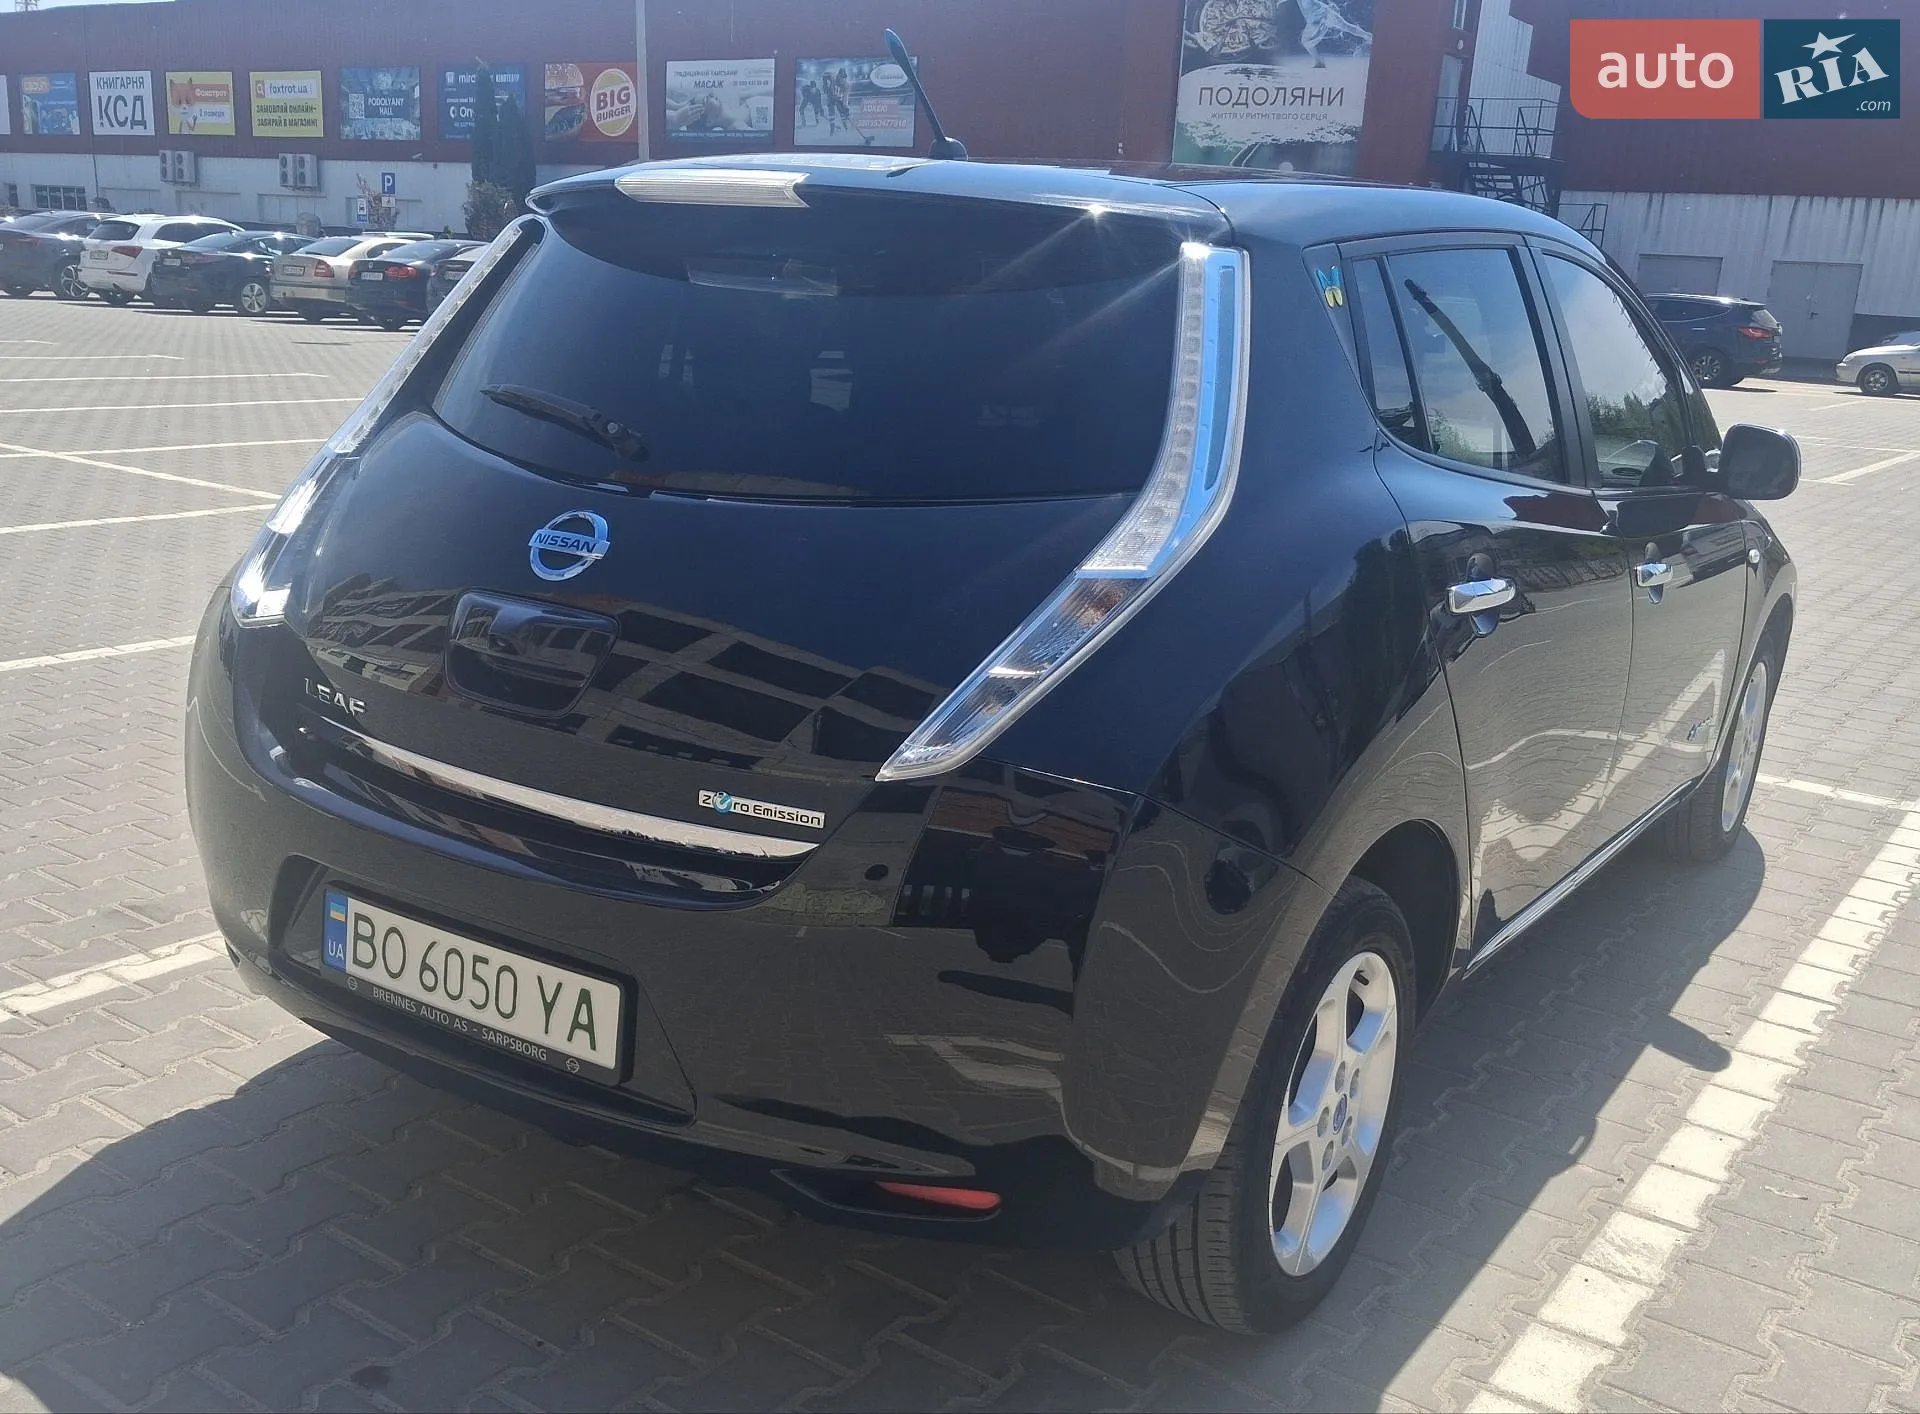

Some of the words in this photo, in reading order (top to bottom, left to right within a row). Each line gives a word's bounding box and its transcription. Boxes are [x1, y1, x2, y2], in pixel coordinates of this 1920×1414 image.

[96, 76, 145, 90] КНИГАРНЯ
[269, 84, 308, 95] foxtrot.ua
[693, 80, 724, 89] МАСАЖ
[368, 97, 404, 107] PODOLYANY
[596, 86, 631, 111] BIG
[1199, 87, 1345, 109] ПОДОЛЯНИ
[98, 94, 147, 130] КСД
[379, 107, 393, 116] HALL
[596, 105, 631, 122] BURGER
[1211, 112, 1238, 120] ЖИТТЯ
[1246, 112, 1270, 120] РИТМІ
[1272, 113, 1298, 121] ТВОГО
[1300, 113, 1328, 121] СЕРЦЯ
[384, 175, 393, 193] P
[534, 533, 597, 553] NISSAN
[304, 677, 366, 716] LEAF
[753, 804, 821, 826] Emission
[328, 938, 345, 961] UA
[352, 912, 407, 979] BO
[419, 941, 518, 1019] 6050
[537, 975, 597, 1051] YA
[373, 986, 417, 1012] BRENNES
[420, 1005, 449, 1025] AUTO
[453, 1018, 468, 1032] AS
[481, 1028, 547, 1061] SARPSBORG
